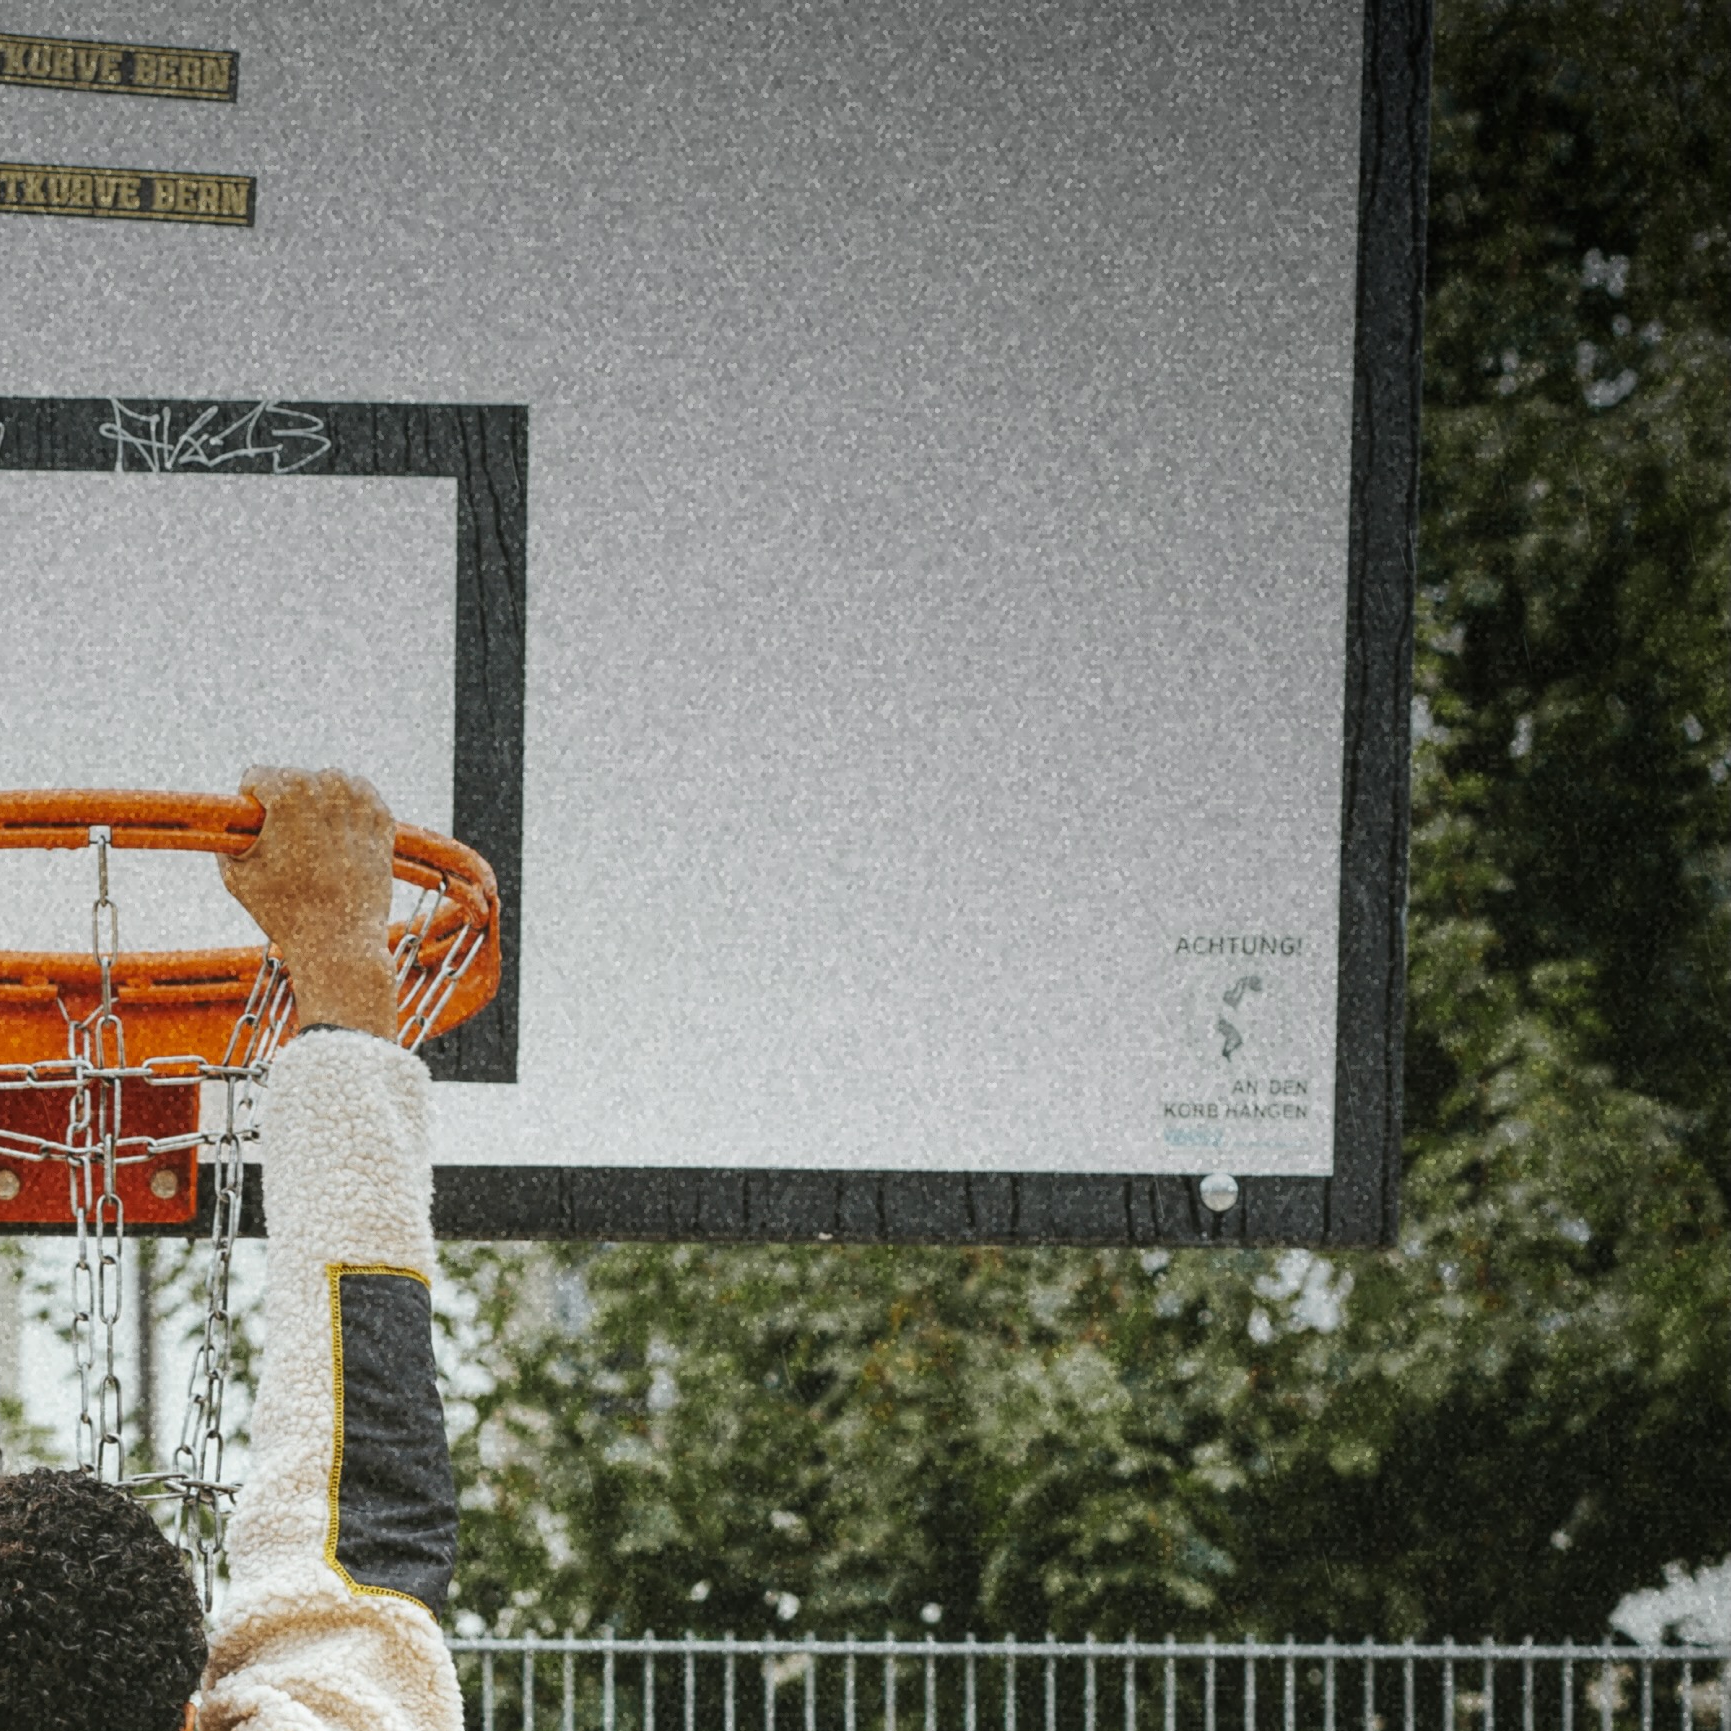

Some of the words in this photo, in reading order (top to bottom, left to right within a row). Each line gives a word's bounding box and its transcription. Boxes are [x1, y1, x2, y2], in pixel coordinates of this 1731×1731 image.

[132, 51, 231, 91] BERN
[150, 178, 250, 216] BERN
[1175, 936, 1303, 956] ACHTUNG!
[1231, 1079, 1258, 1095] AN
[1268, 1079, 1308, 1095] DEN
[1163, 1102, 1218, 1119] KORB
